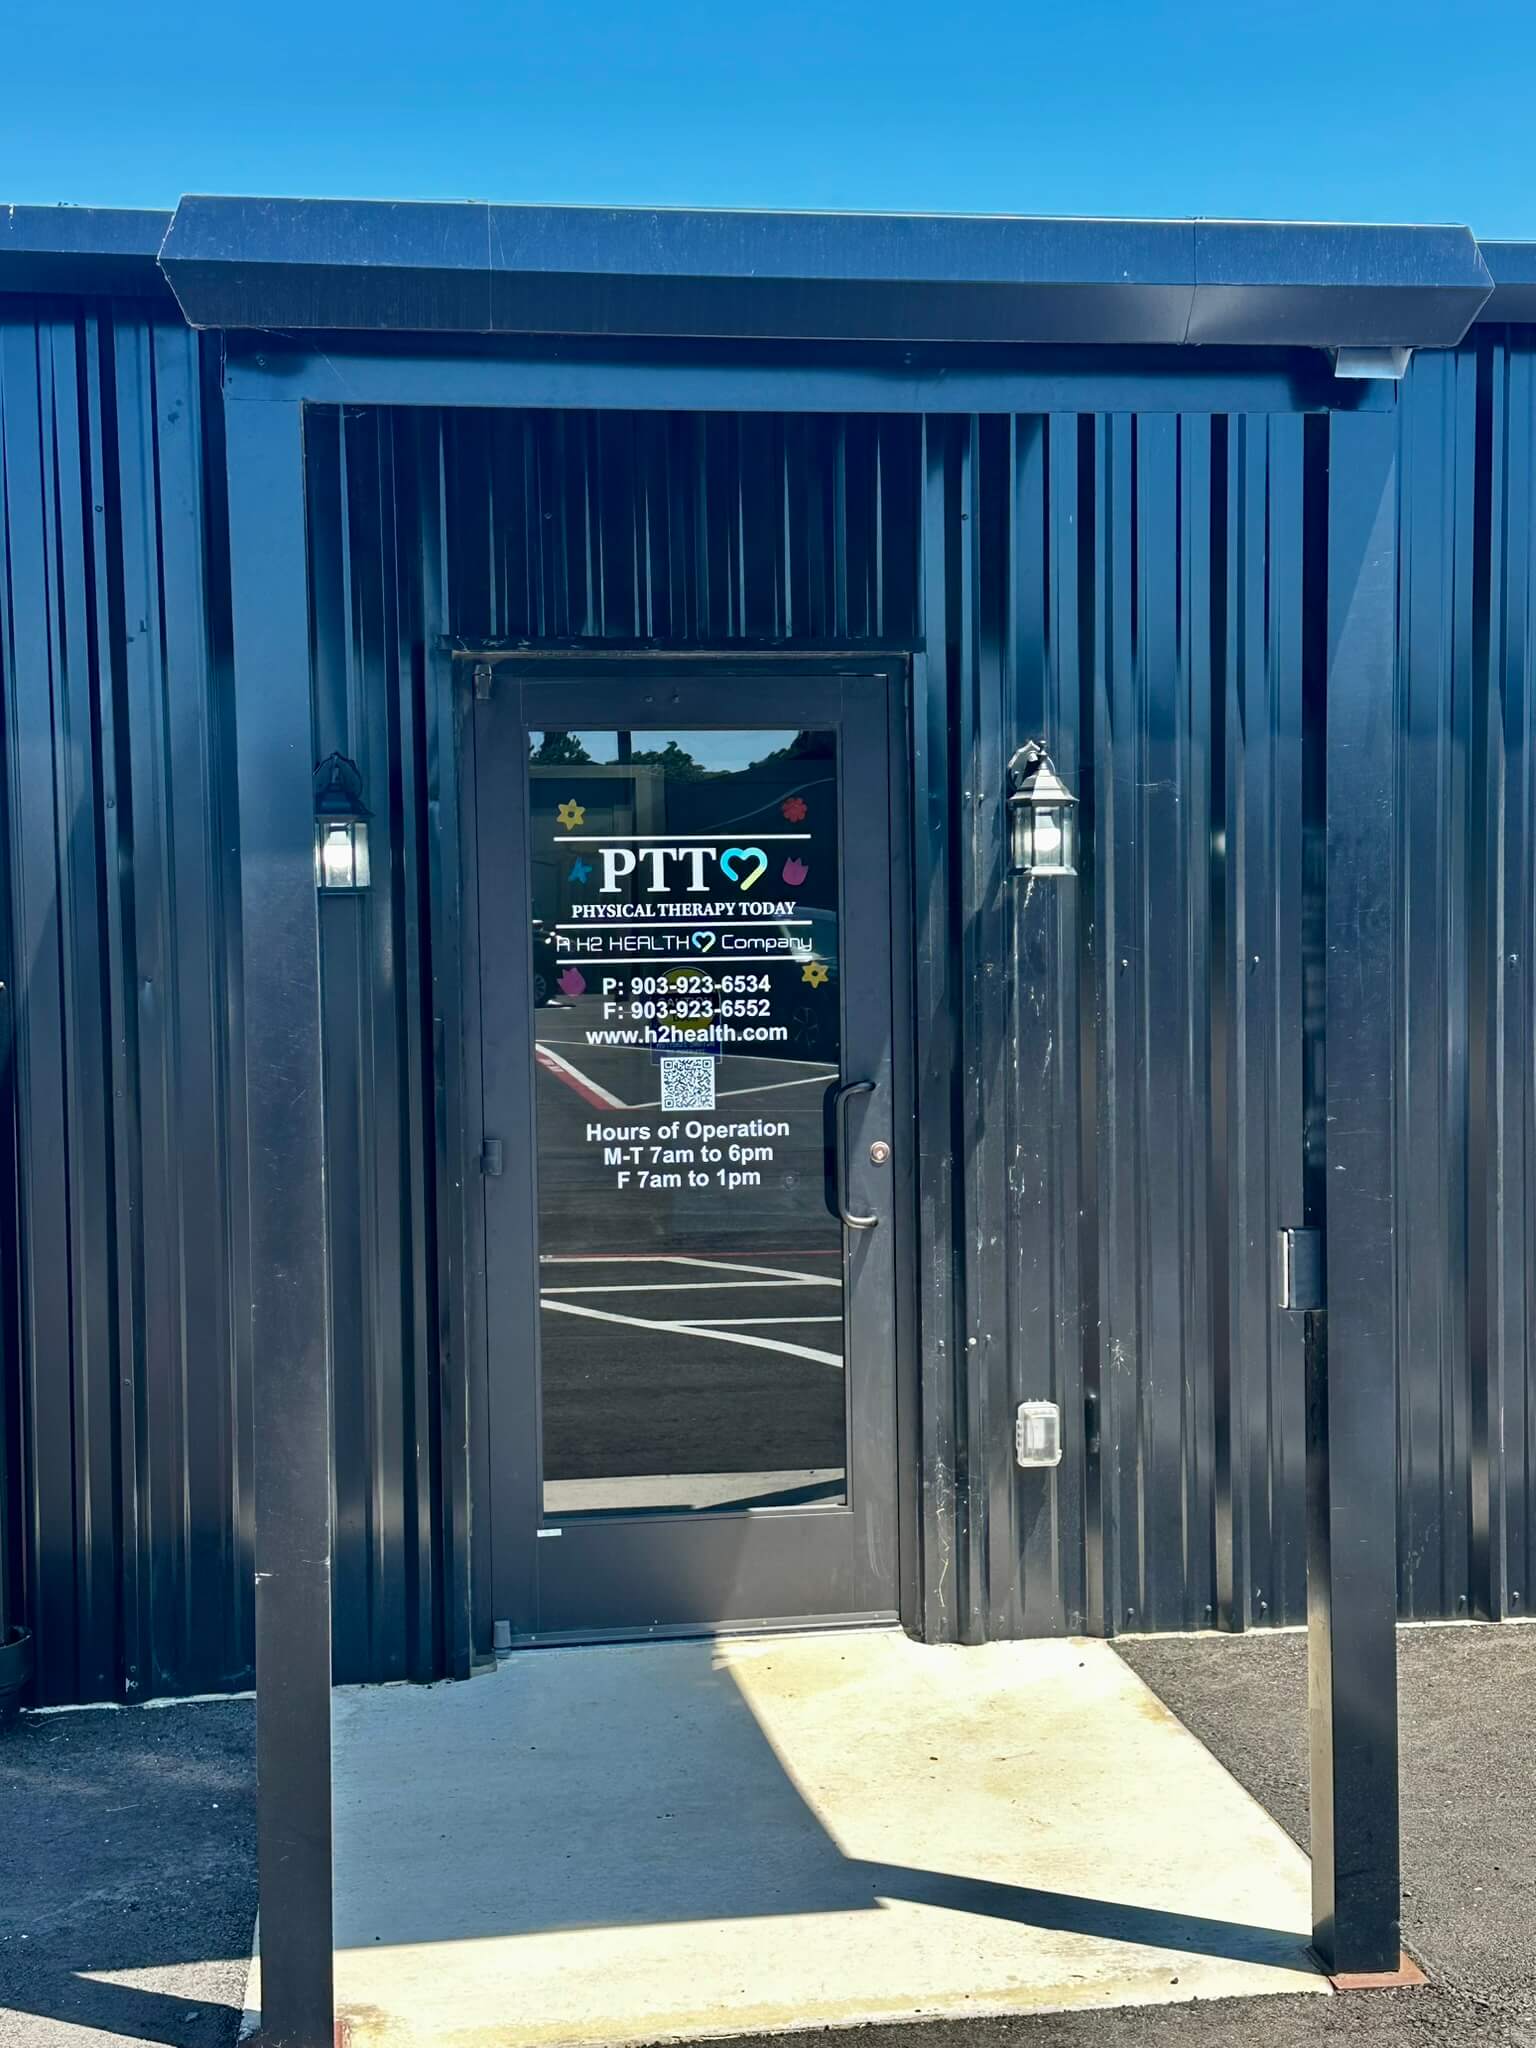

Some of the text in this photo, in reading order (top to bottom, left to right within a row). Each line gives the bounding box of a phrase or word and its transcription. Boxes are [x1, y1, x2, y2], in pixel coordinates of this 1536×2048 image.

[599, 847, 717, 892] PTT
[572, 901, 797, 919] PHYSICAL THERAPY TODAY
[556, 934, 812, 953] A H2 HEALTH Company
[603, 975, 771, 995] P: 903-923-6534
[604, 1002, 623, 1020] F:
[631, 1000, 770, 1019] 903-923-6552
[586, 1025, 788, 1045] www.h2health.com
[586, 1120, 790, 1142] Hours of Operation
[604, 1145, 773, 1165] M-T 7am to 6pm
[617, 1170, 761, 1189] F 7am to 1pm
